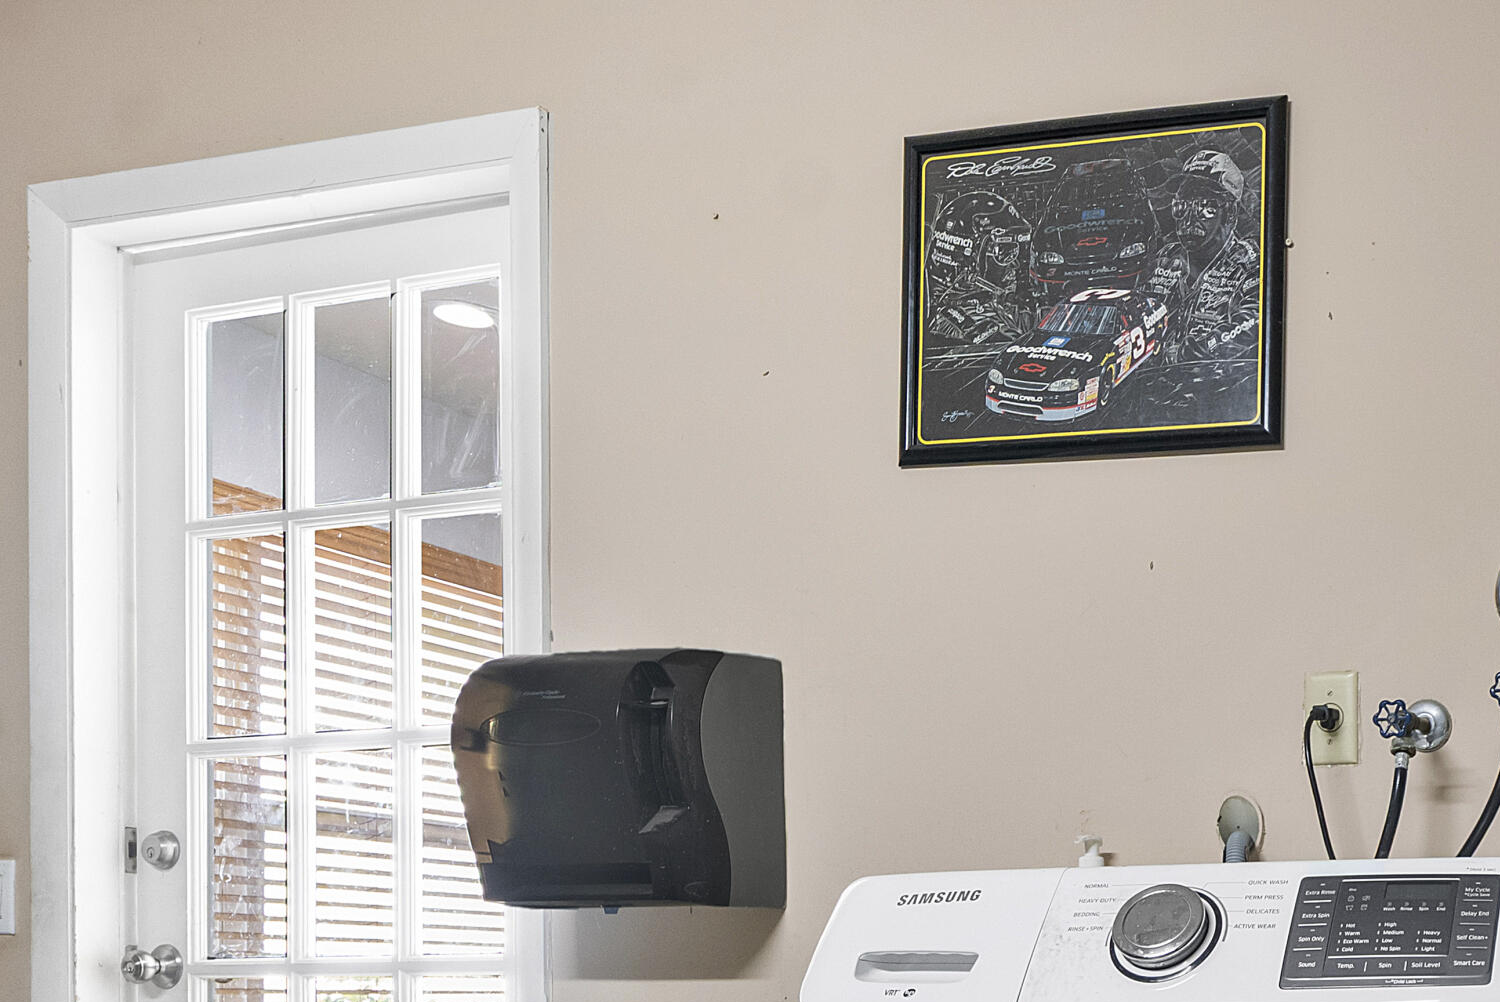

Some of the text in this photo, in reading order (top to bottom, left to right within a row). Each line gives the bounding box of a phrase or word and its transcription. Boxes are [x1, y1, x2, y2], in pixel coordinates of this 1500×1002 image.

[1006, 345, 1093, 362] Goodwrench
[1027, 353, 1057, 361] Service
[998, 391, 1019, 399] MONTE
[897, 889, 982, 906] SAMSUNG
